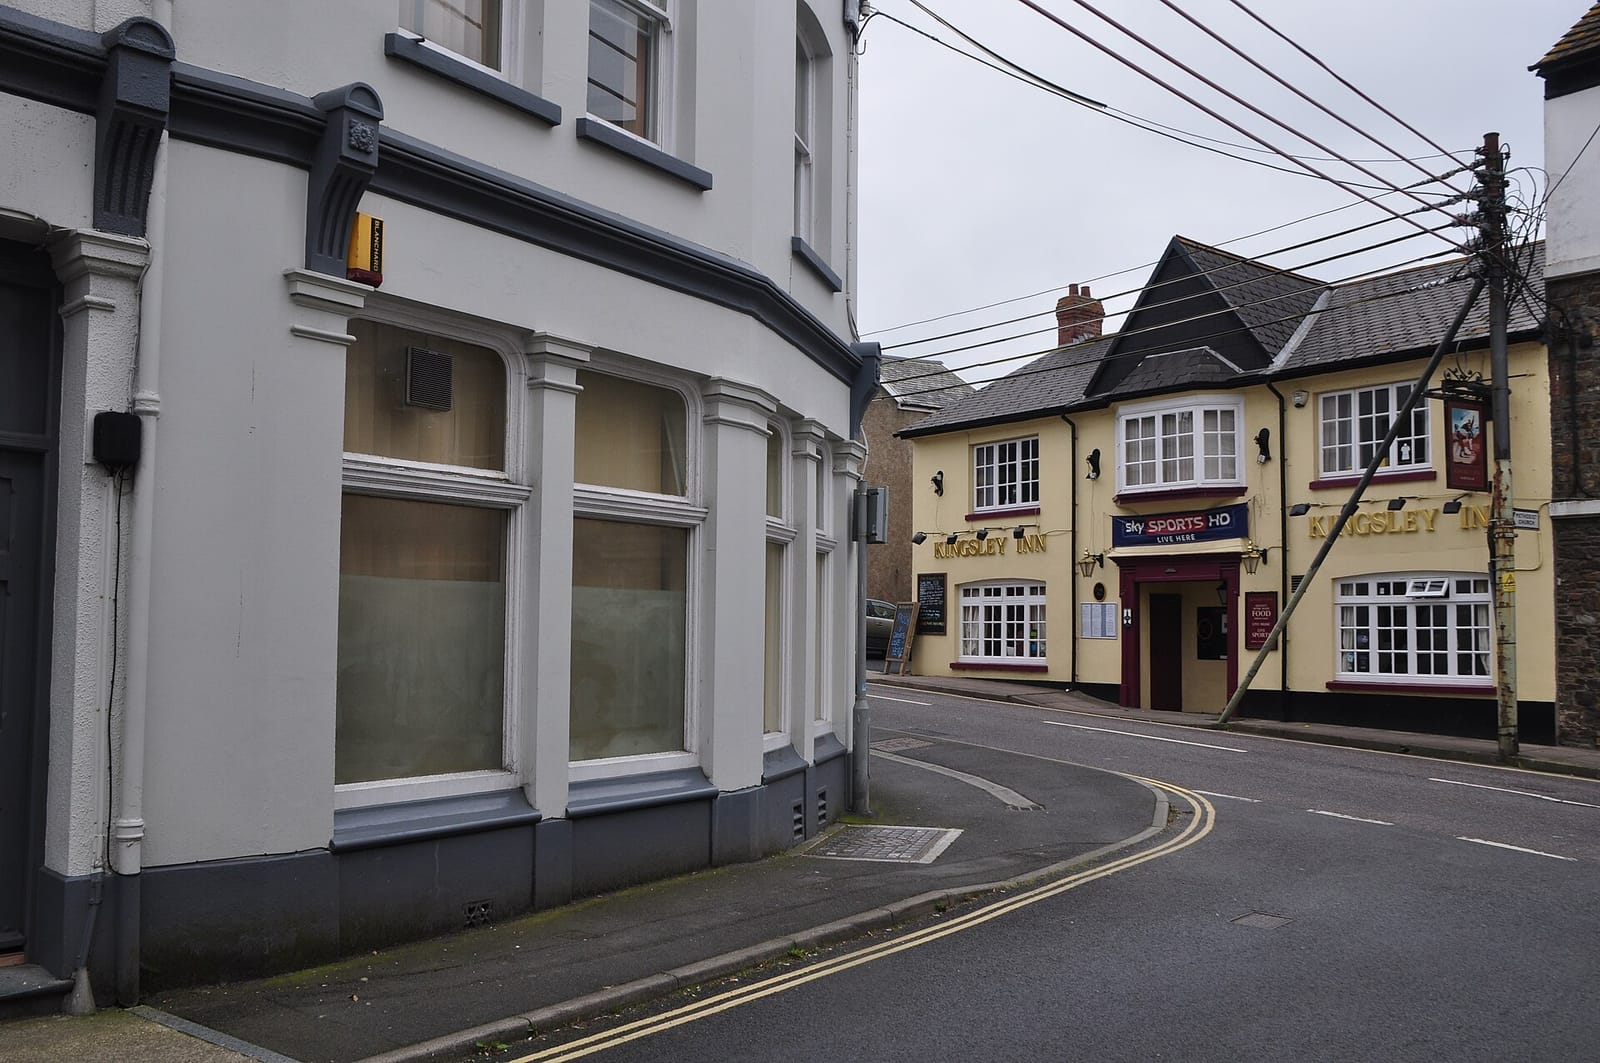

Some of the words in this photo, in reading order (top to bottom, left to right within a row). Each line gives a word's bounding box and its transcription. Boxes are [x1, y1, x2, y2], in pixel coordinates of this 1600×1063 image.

[1125, 520, 1144, 535] sky
[1147, 517, 1204, 533] SPORTS
[1208, 513, 1230, 528] HD
[1460, 503, 1489, 529] IN
[934, 536, 1007, 559] KINGSLEY
[1016, 534, 1047, 555] INN
[1175, 534, 1195, 542] HERE
